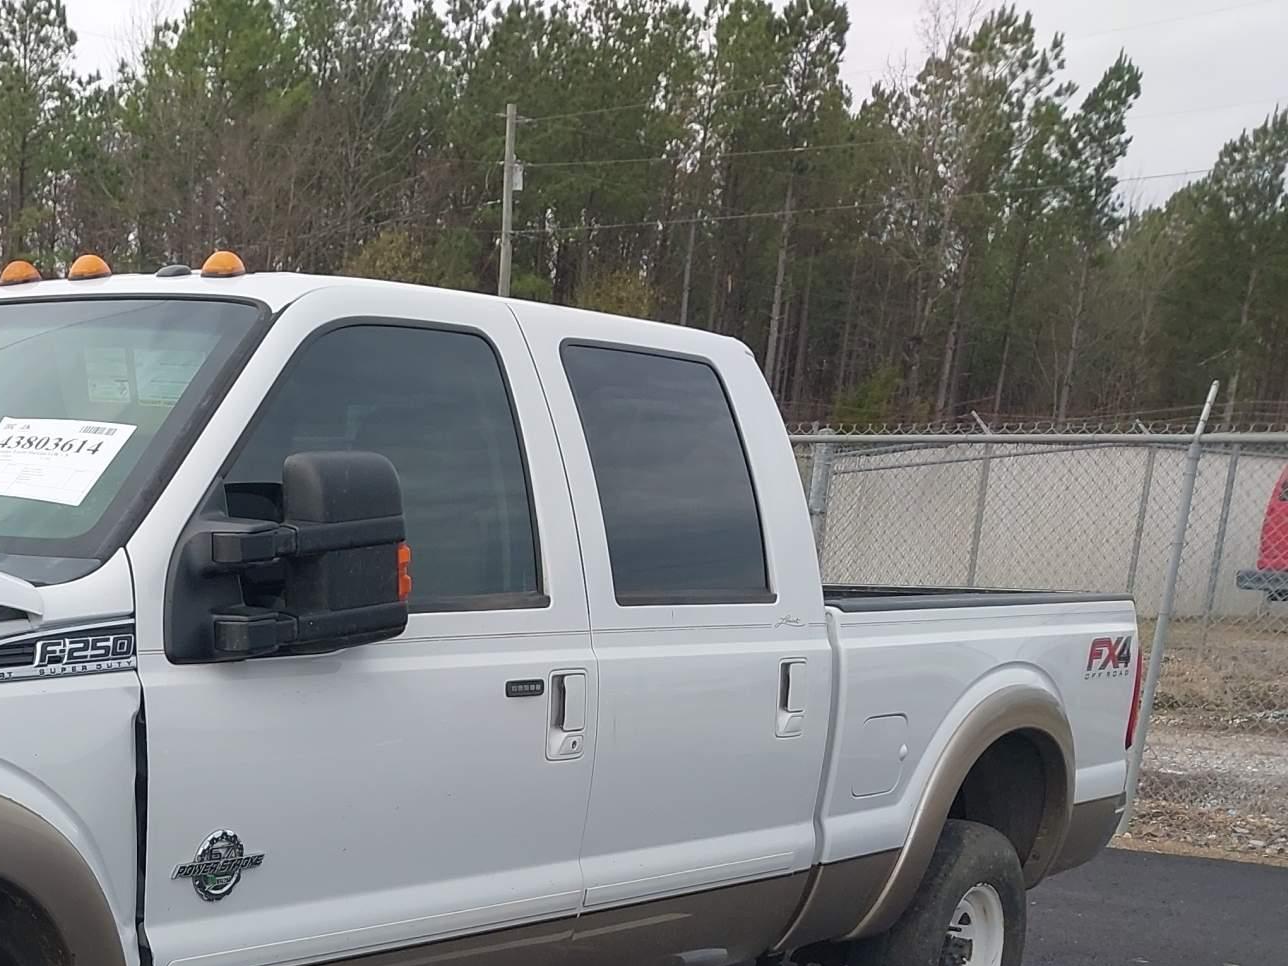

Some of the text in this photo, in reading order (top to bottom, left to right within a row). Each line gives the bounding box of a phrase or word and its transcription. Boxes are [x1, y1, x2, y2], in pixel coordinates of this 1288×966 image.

[34, 634, 134, 667] F-250
[1087, 636, 1132, 671] FX4
[39, 661, 132, 676] SUPER DUTY
[1084, 669, 1129, 680] OFF ROAD
[176, 854, 264, 878] POWER STROKE
